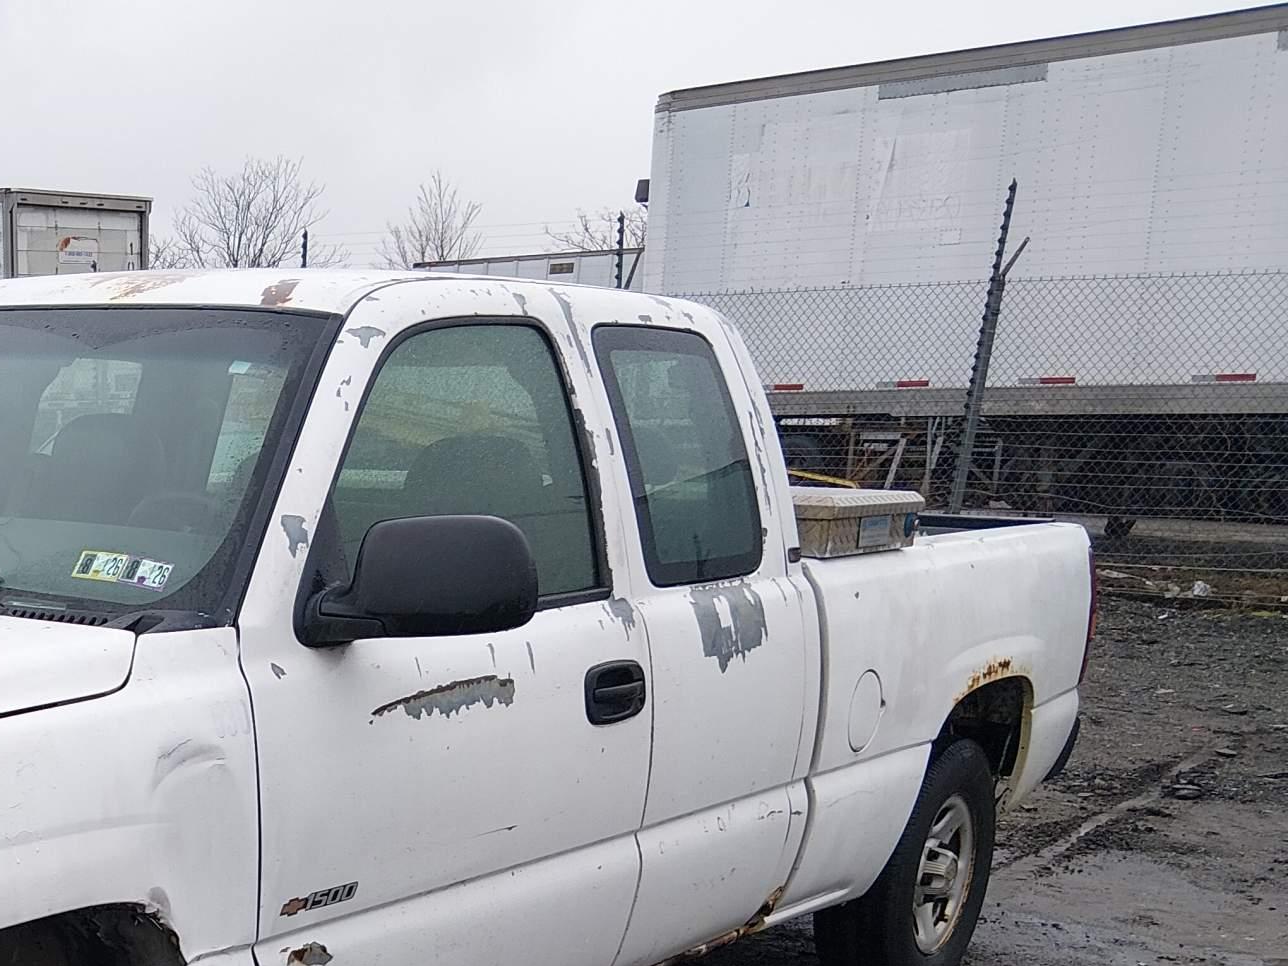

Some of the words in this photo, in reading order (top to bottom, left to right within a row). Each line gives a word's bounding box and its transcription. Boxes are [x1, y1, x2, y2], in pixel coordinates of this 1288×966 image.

[106, 557, 124, 577] 26
[152, 565, 170, 585] 26
[305, 882, 359, 910] 1500
